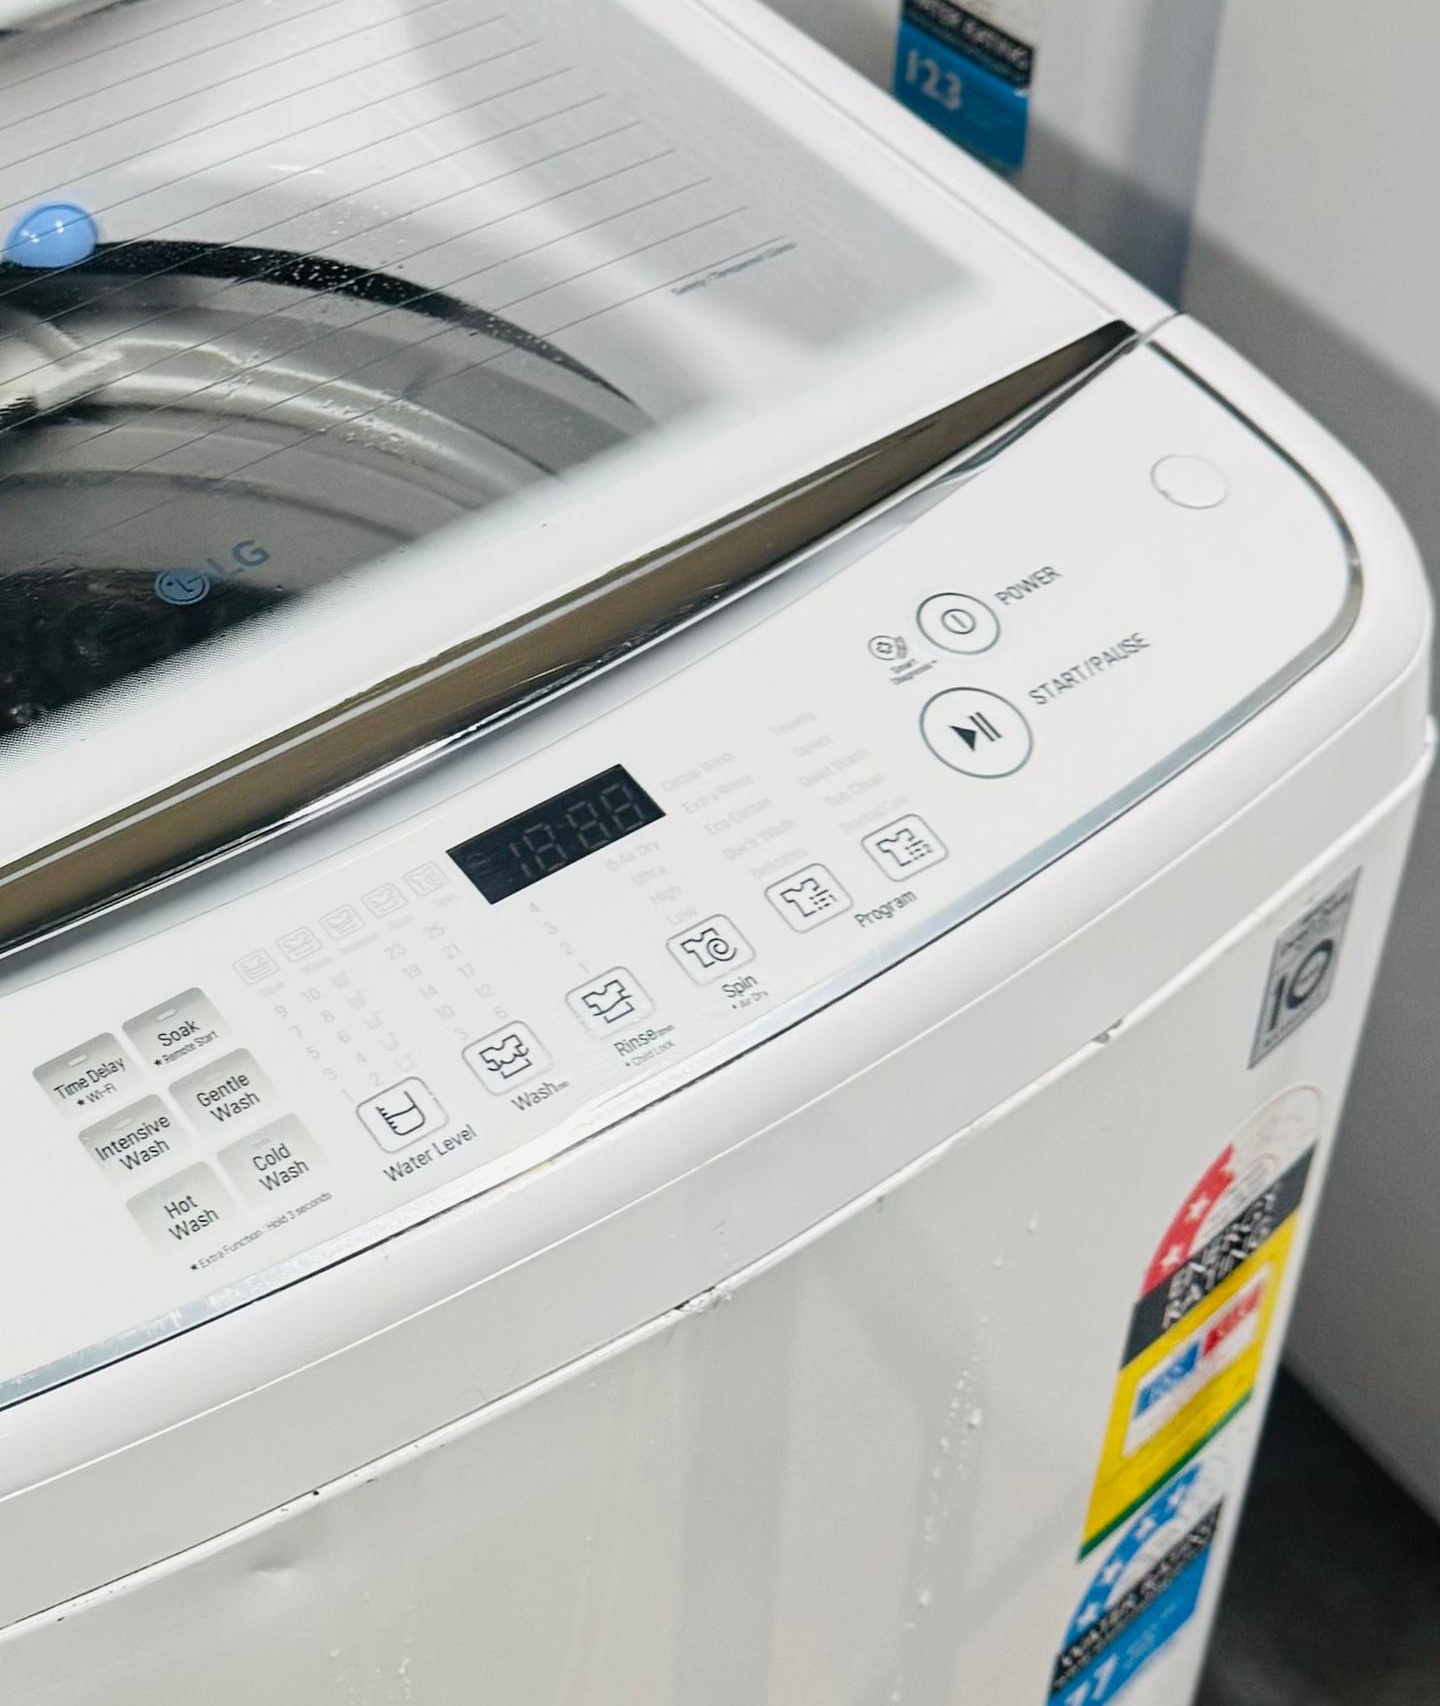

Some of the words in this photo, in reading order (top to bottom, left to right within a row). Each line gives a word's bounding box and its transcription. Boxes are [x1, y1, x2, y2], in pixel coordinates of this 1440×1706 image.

[905, 47, 963, 111] 123
[206, 539, 271, 580] LG
[994, 564, 1062, 606] POWER
[1028, 631, 1152, 706] START/PAUSE
[854, 889, 917, 927] Program
[721, 975, 758, 998] Spin
[157, 1020, 200, 1047] Soak
[614, 1029, 657, 1056] Rinse
[54, 1077, 90, 1100] Time
[87, 1056, 126, 1083] Delay
[196, 1072, 251, 1108] Gentle
[210, 1091, 261, 1123] Wash
[511, 1082, 559, 1111] Wash
[94, 1114, 171, 1162] Intensive
[119, 1138, 171, 1171] Wash
[383, 1146, 433, 1182] Water
[432, 1124, 478, 1157] Level
[252, 1142, 292, 1172] Cold
[259, 1158, 310, 1191] Wash
[164, 1194, 198, 1220] Hot
[168, 1207, 219, 1241] Wash
